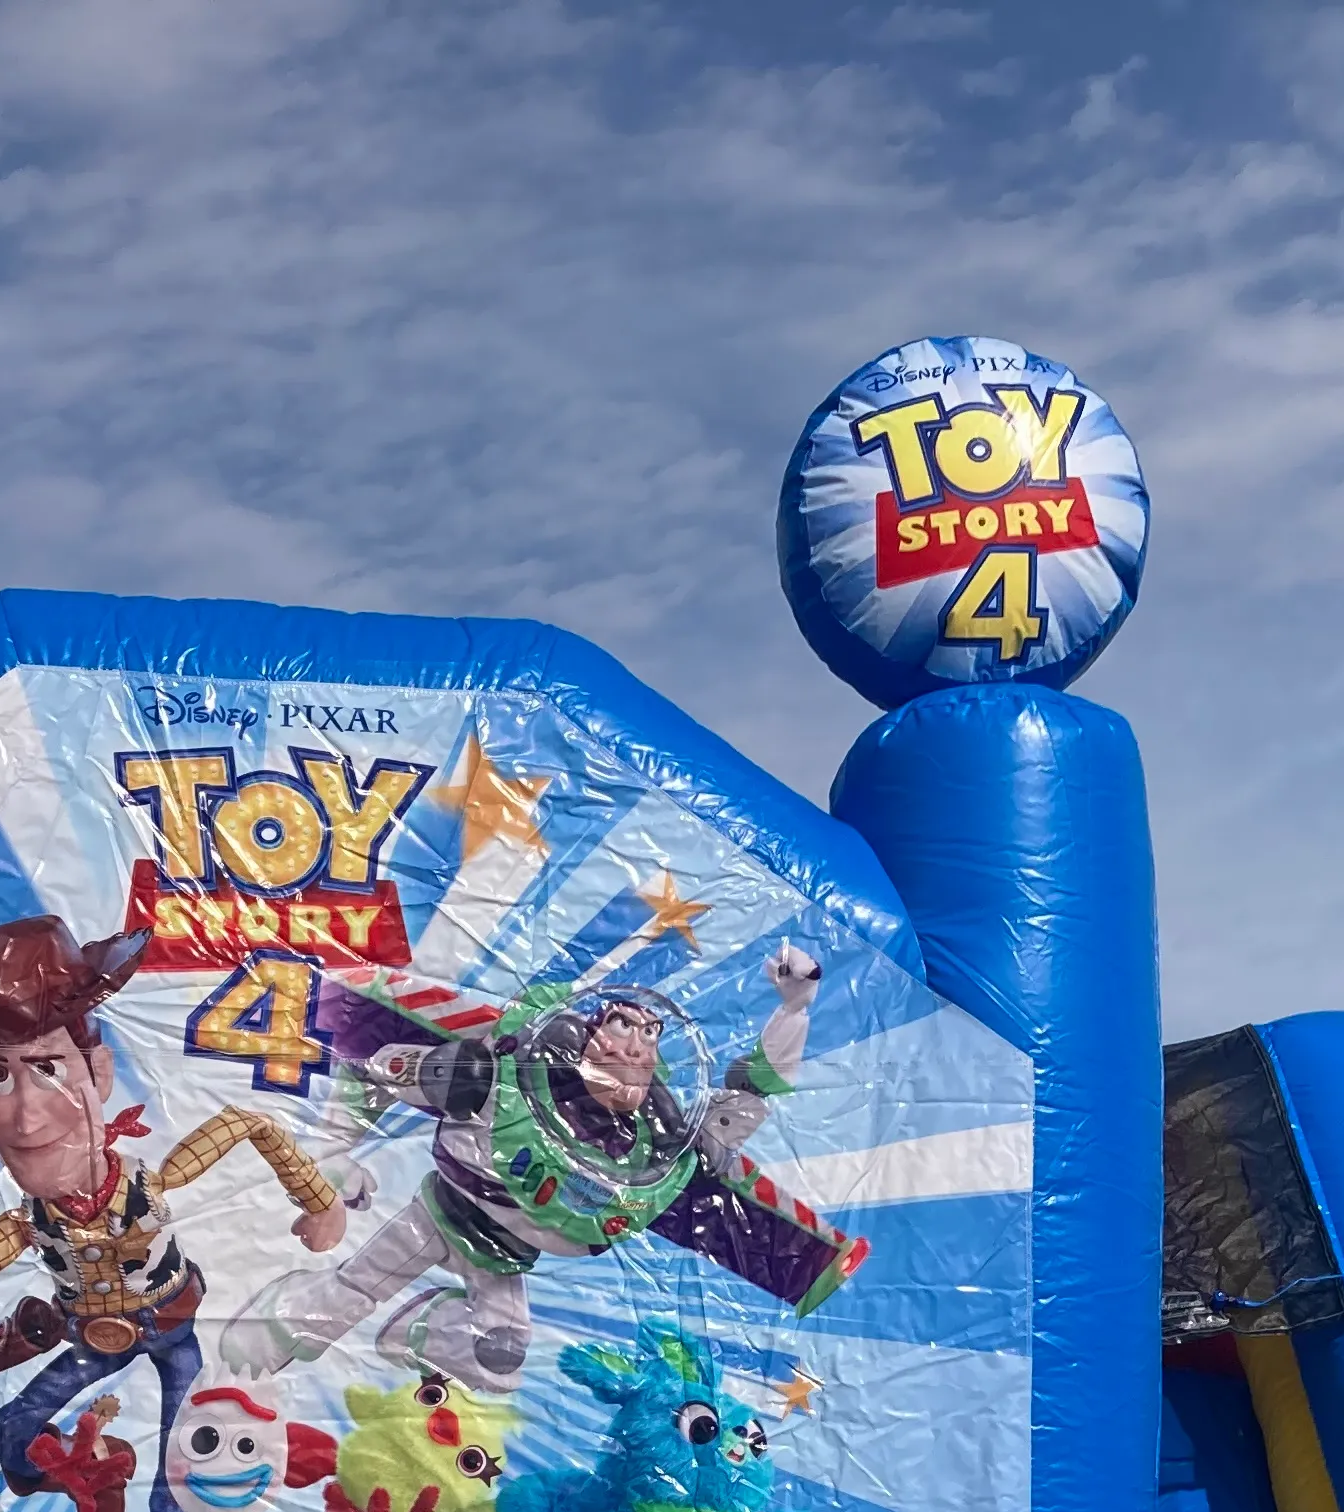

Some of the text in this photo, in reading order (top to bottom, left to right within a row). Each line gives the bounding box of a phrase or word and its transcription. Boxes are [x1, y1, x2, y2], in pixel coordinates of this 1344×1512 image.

[860, 364, 957, 393] Disney
[850, 382, 1087, 512] TOY
[897, 498, 1077, 553] STORY
[937, 543, 1050, 666] 4
[137, 686, 400, 741] Disney PIXAR
[113, 745, 438, 899] TOY
[152, 895, 384, 949] STORY
[183, 948, 334, 1098] 4
